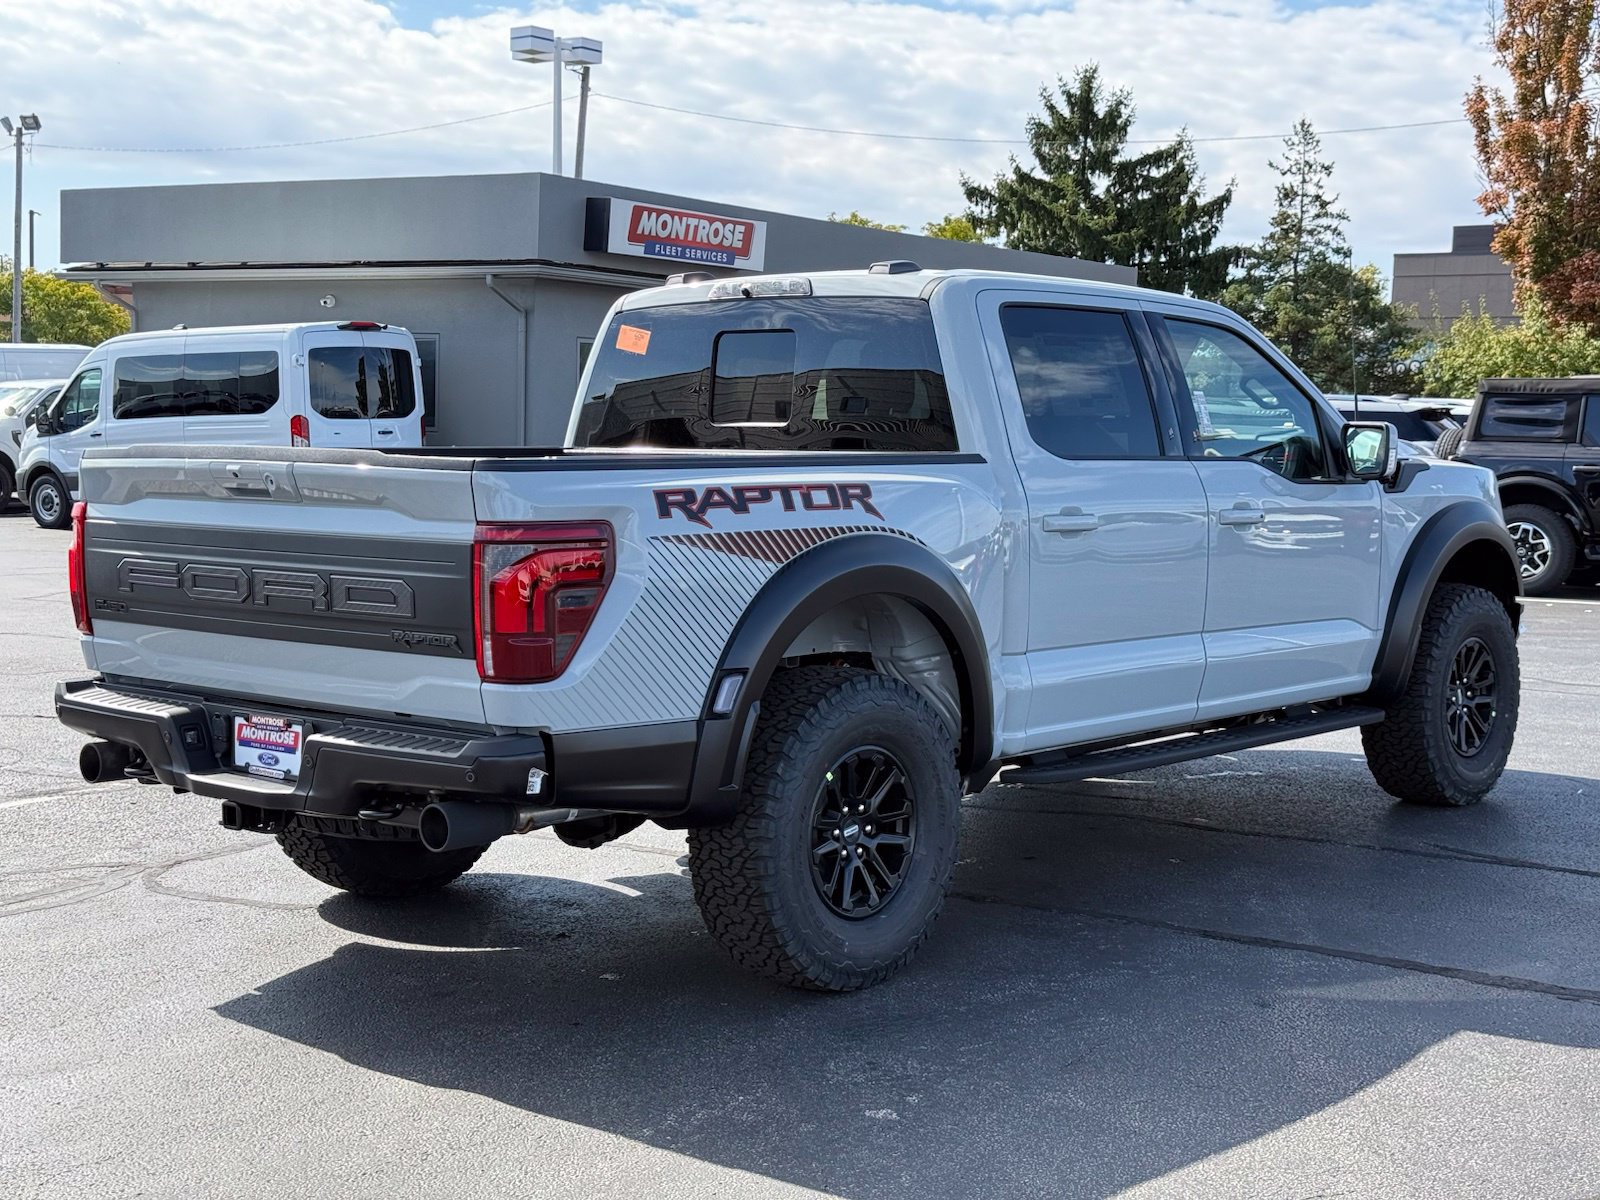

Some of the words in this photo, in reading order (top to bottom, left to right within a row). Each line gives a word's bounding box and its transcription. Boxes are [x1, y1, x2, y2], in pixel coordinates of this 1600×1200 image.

[636, 210, 745, 248] MONTROSE
[655, 244, 682, 256] FLEET
[685, 249, 728, 262] SERVICES
[652, 482, 885, 529] RAPTOR
[117, 557, 415, 618] FORD
[391, 629, 464, 654] RAPTOR
[251, 716, 284, 727] MONTROSE
[241, 725, 296, 745] MONTROSE
[261, 753, 276, 765] Ford
